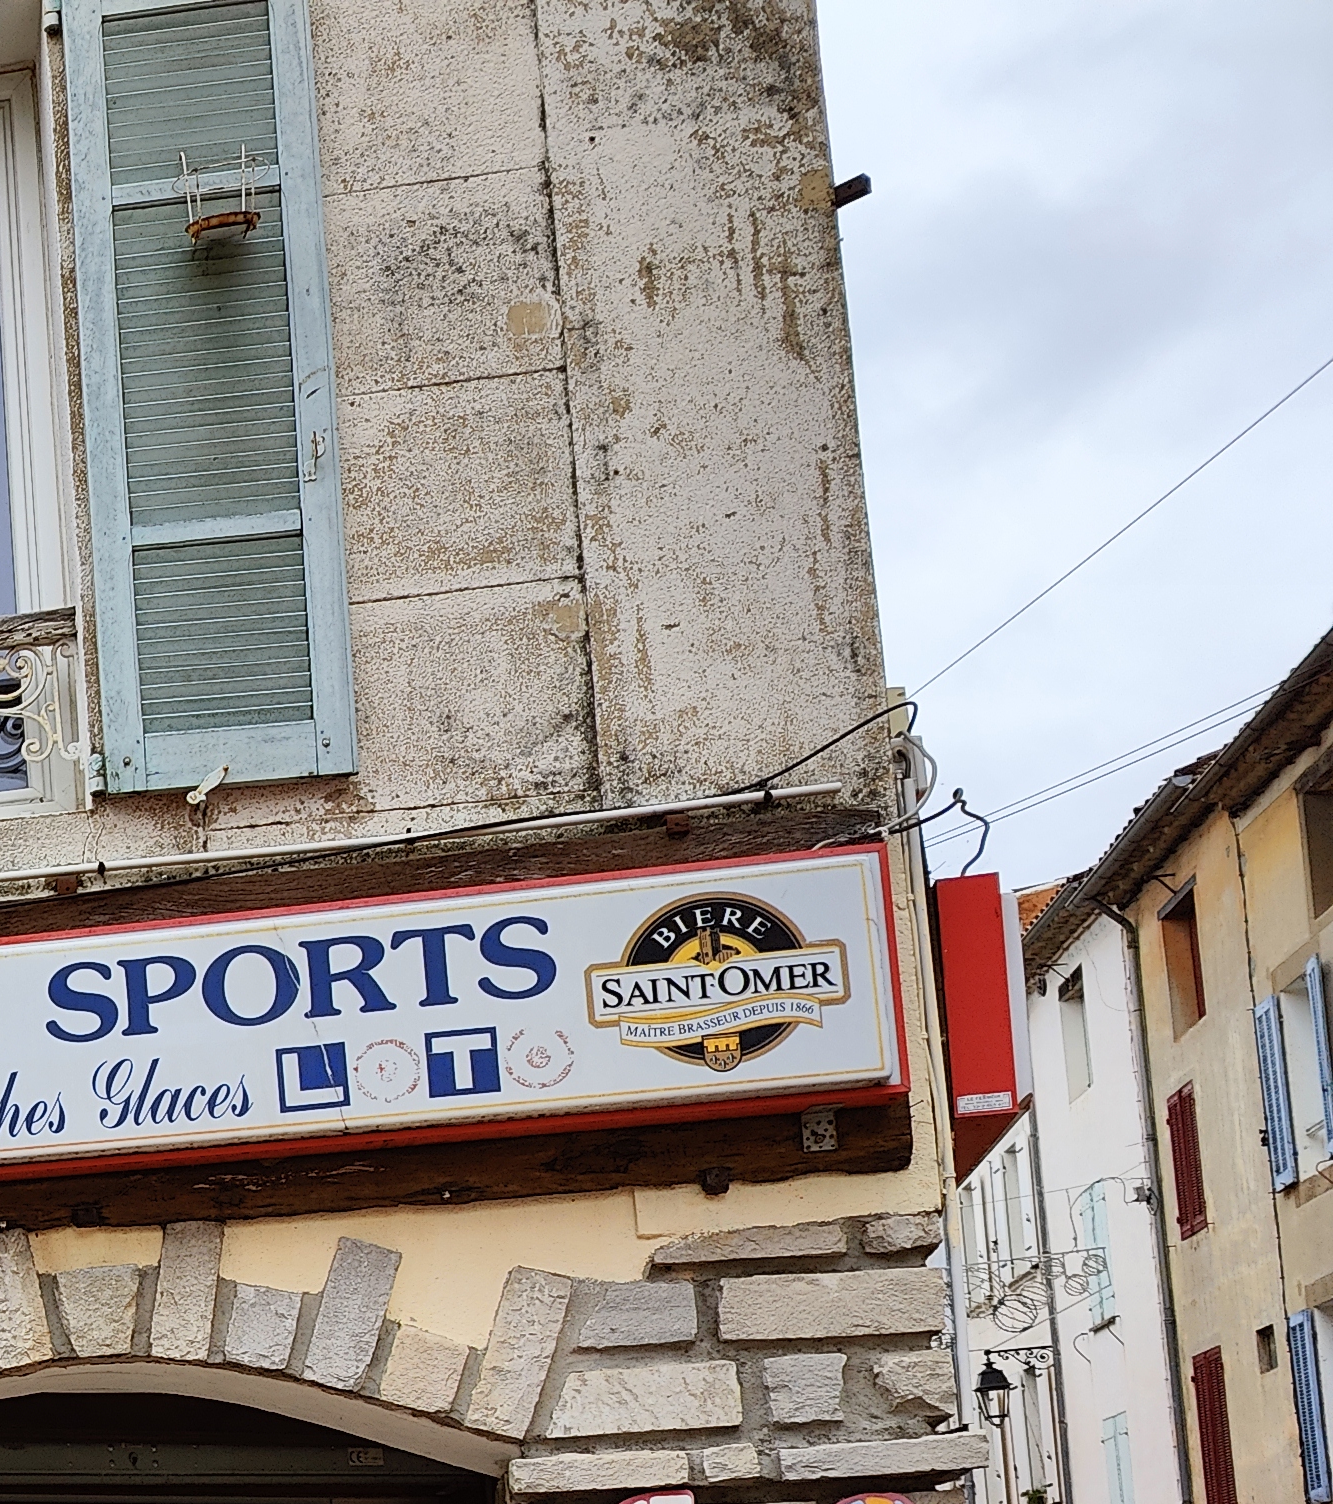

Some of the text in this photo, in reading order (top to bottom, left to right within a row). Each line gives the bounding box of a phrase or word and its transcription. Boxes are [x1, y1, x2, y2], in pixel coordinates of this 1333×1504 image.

[650, 906, 772, 950] BIERE
[44, 915, 557, 1043] SPORTS
[678, 1011, 742, 1034] BRASSEUR
[743, 1002, 786, 1019] DEPUIS
[789, 1001, 815, 1015] 1866
[92, 1056, 254, 1129] Glaces
